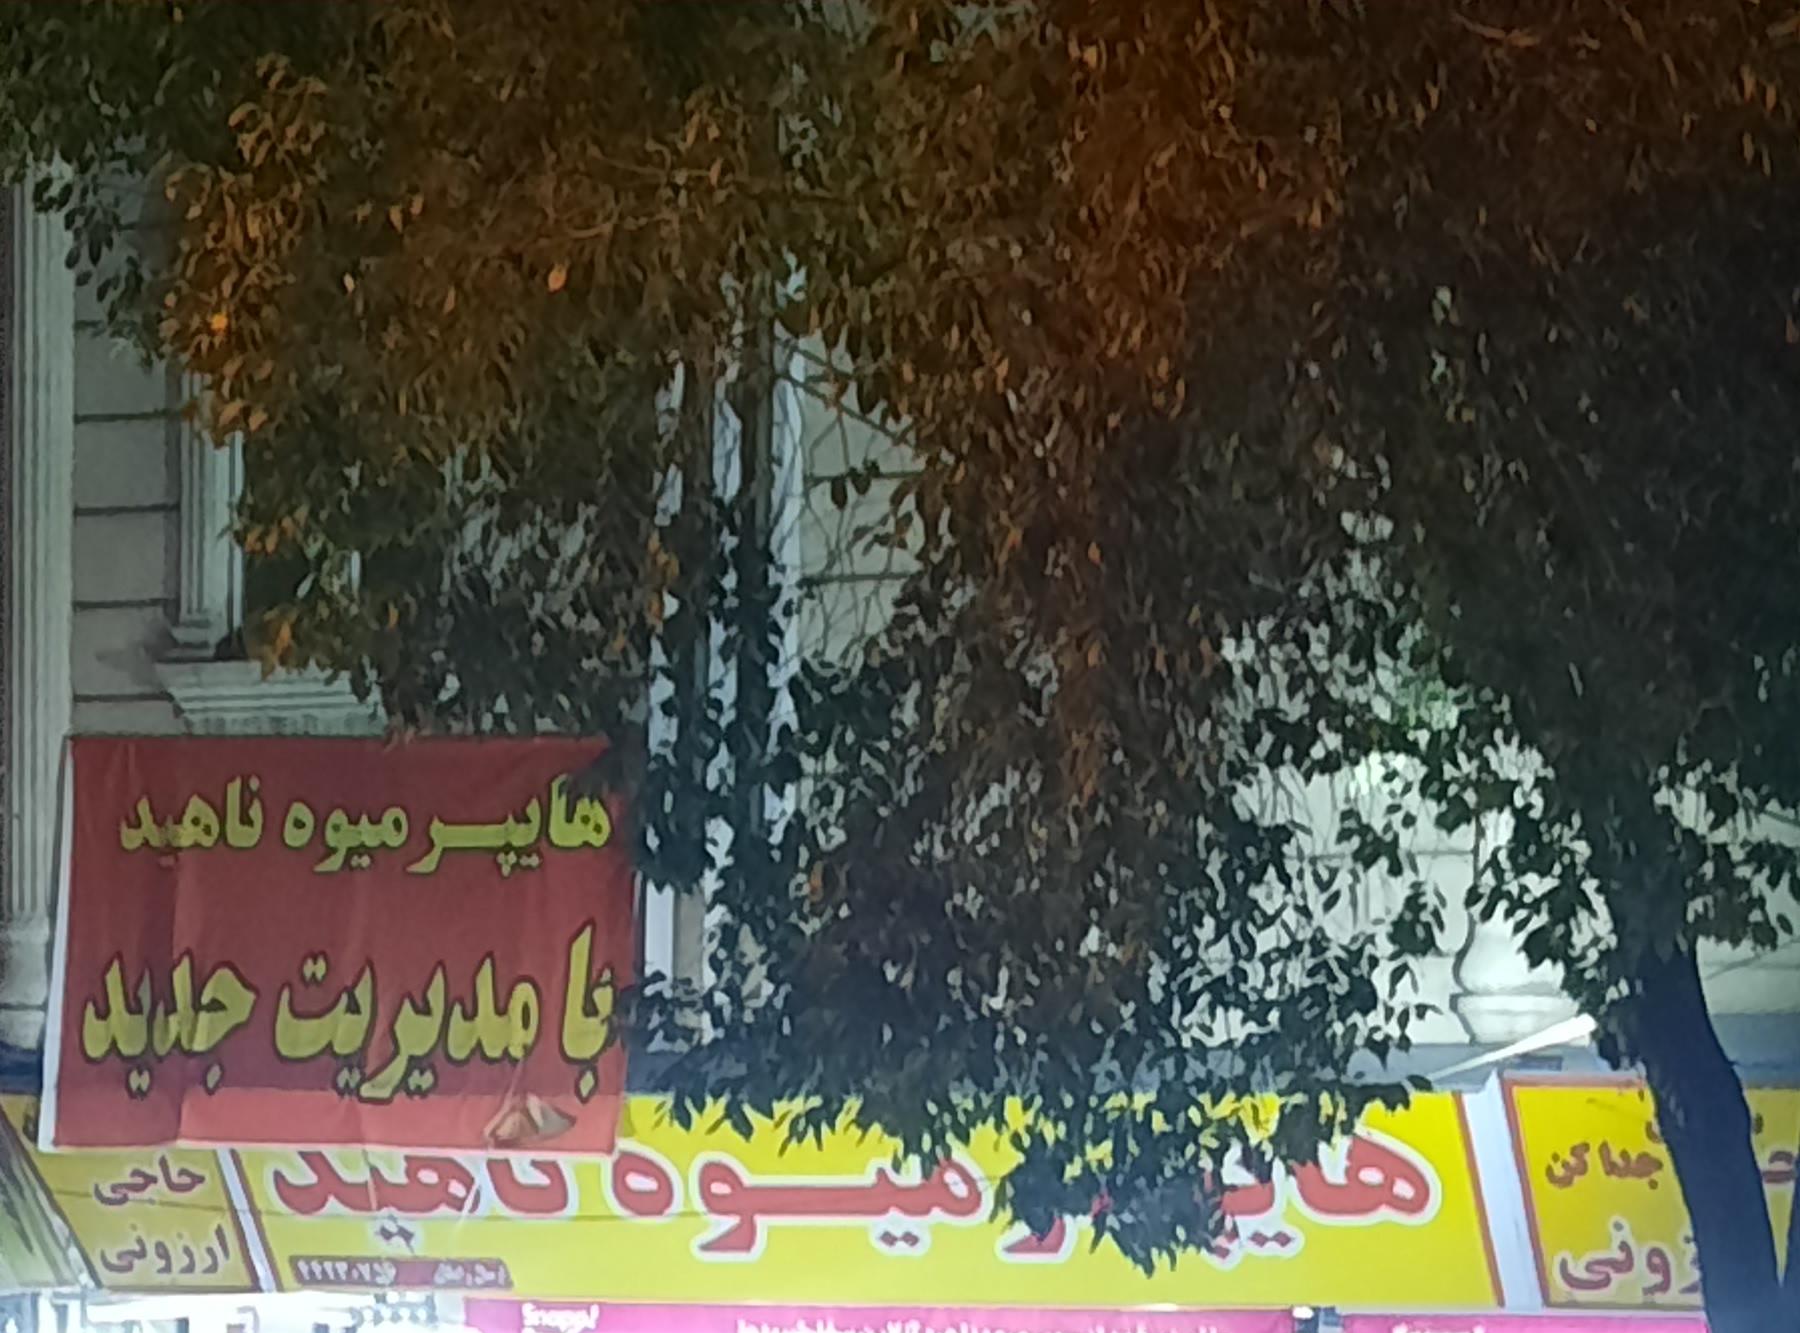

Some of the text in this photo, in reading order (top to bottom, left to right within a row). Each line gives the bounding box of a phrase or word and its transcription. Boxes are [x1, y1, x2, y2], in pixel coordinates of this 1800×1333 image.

[119, 774, 612, 877] هایپر میوه ناهید
[81, 920, 618, 1104] با مدیریت جدید
[93, 1155, 206, 1206] حاجی
[611, 1153, 984, 1253] میوه
[100, 1223, 230, 1275] ارزونی
